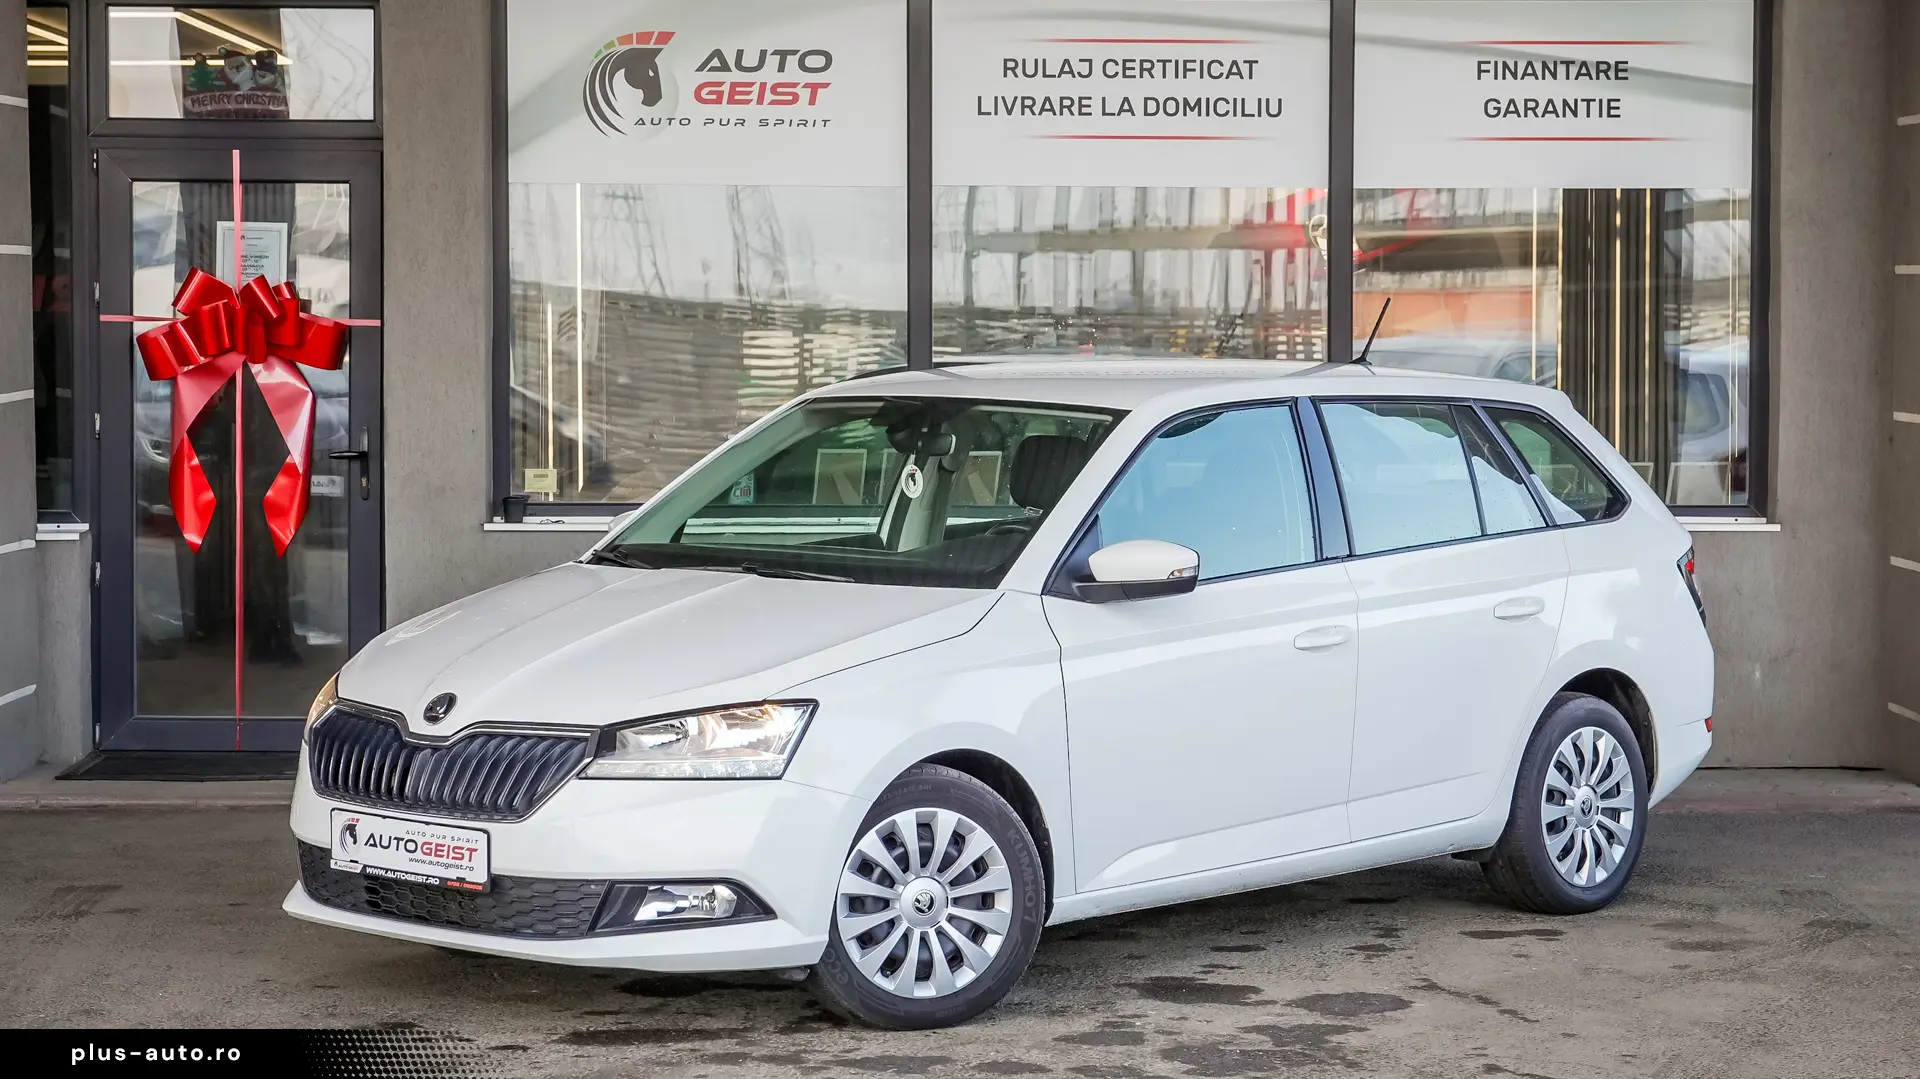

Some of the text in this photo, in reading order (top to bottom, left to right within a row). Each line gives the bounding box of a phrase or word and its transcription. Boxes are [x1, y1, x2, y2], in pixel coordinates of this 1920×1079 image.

[694, 48, 833, 73] AUTO
[1002, 58, 1259, 80] RULAJ CERTIFICAT
[1476, 60, 1629, 81] FINANTARE
[190, 94, 232, 108] MERRY
[693, 81, 832, 106] GEIST
[977, 96, 1283, 118] LIVRARE LA DOMICILIU
[1483, 98, 1622, 119] GARANTIE
[634, 117, 832, 128] AUTO PUR SPIRIT
[405, 829, 427, 837] AUTO
[450, 836, 479, 844] SPIRIT
[408, 857, 475, 872] www.autogeist.ro
[1007, 828, 1036, 908] KUMHO
[366, 866, 440, 885] WWW.AUTOGEIST.RO
